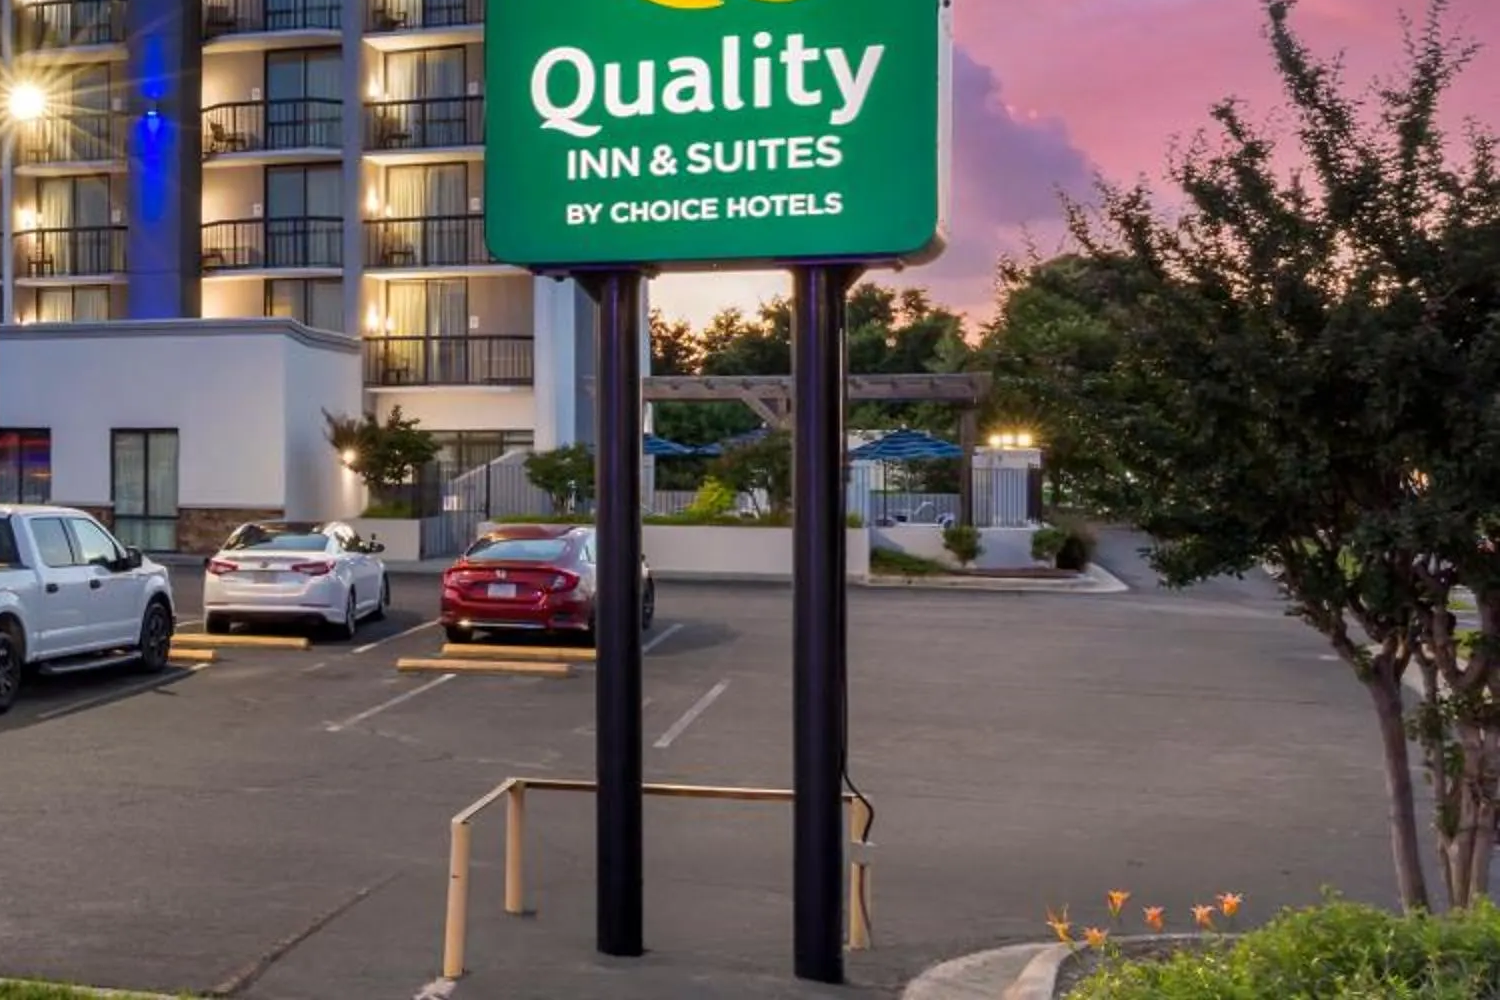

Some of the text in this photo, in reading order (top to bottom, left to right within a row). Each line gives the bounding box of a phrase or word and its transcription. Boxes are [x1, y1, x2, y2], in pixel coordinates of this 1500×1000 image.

[530, 31, 886, 138] Quality
[567, 135, 843, 181] INN & SUITES
[567, 192, 843, 226] BY CHOICE HOTELS
